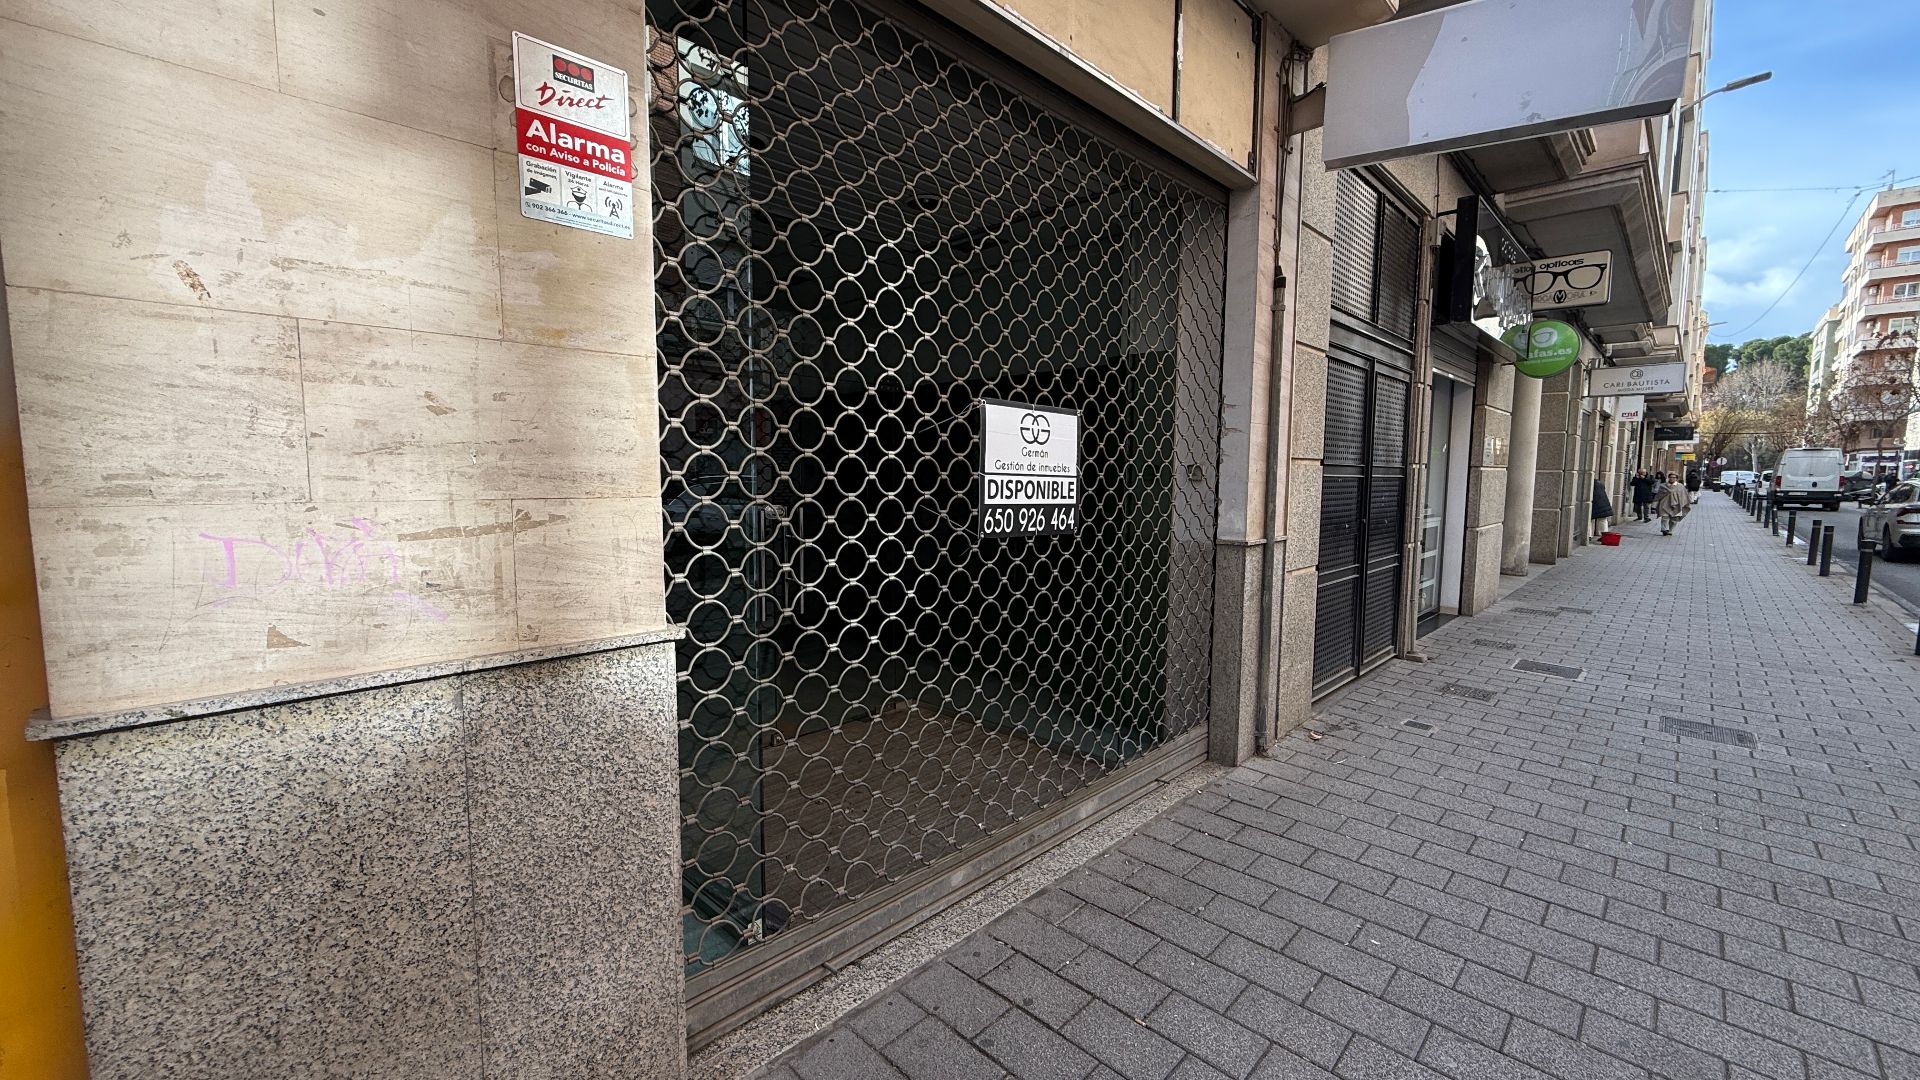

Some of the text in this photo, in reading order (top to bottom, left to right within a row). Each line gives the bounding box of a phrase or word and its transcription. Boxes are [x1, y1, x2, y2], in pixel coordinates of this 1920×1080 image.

[554, 71, 594, 91] SECURITAS
[535, 81, 615, 110] Direct
[525, 119, 625, 164] Alarma
[526, 143, 626, 177] con Aviso a Policía
[526, 160, 557, 173] Grabación
[565, 170, 592, 183] Vigilante
[603, 180, 624, 191] Alarma
[531, 202, 543, 211] 902
[1528, 347, 1573, 359] afas.es
[1603, 379, 1671, 389] CARI BAUTISTA
[1021, 446, 1049, 459] Germán
[994, 459, 1071, 474] Gestión de inmuebles
[987, 478, 1075, 500] DISPONIBLE
[984, 507, 1075, 533] 650 926 464
